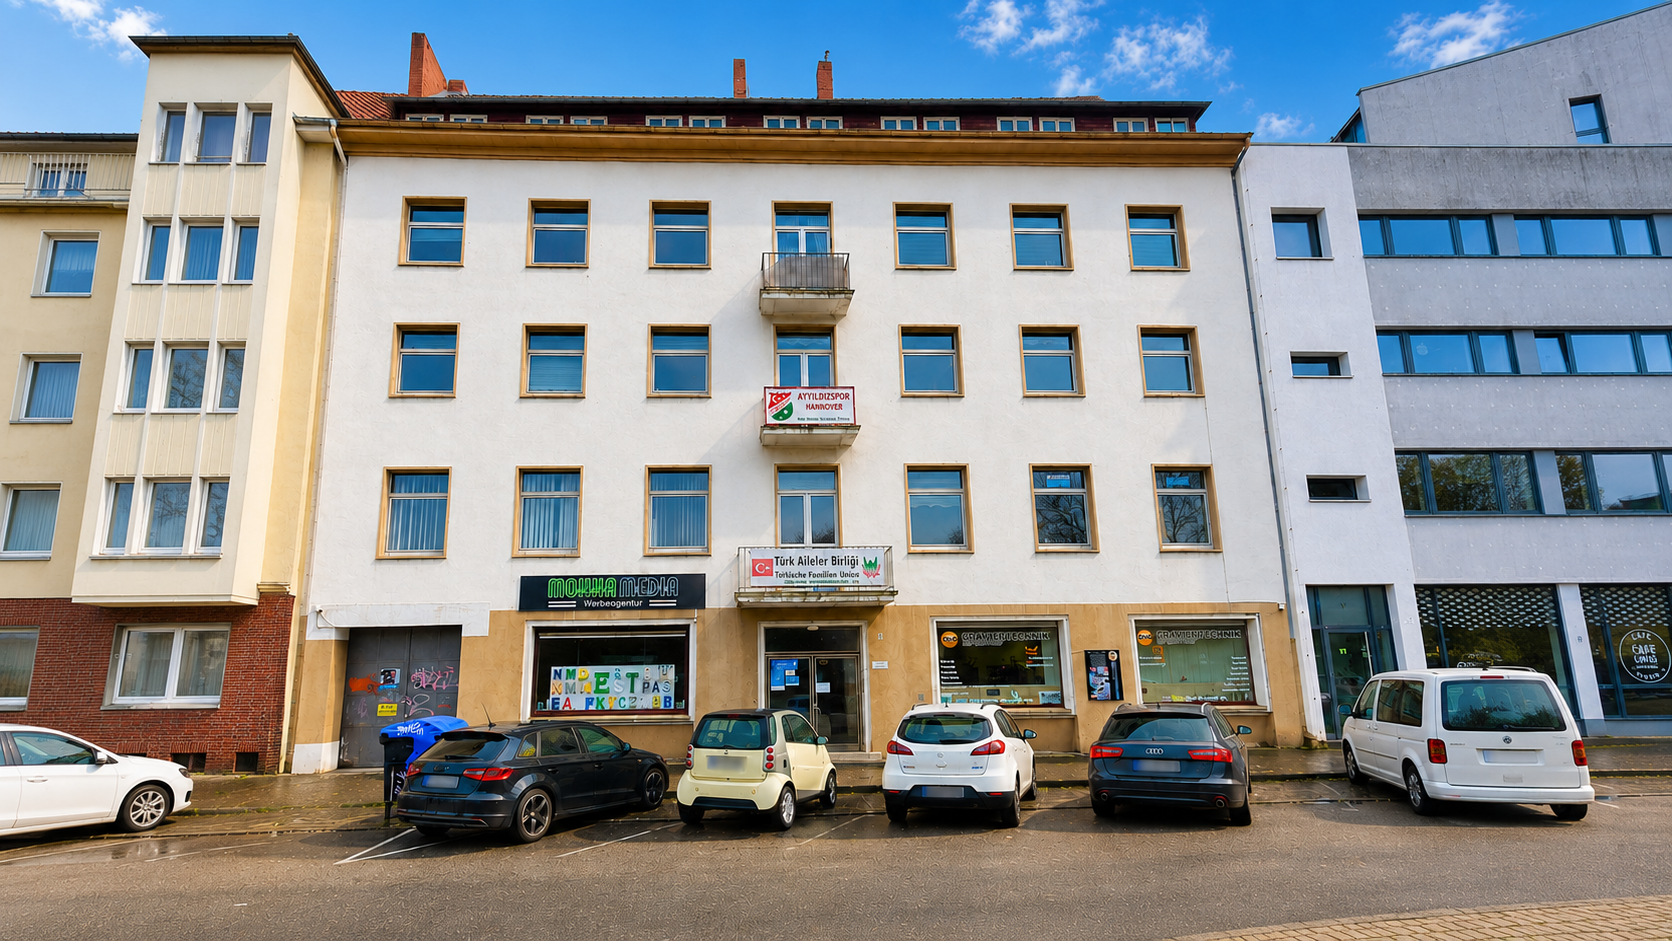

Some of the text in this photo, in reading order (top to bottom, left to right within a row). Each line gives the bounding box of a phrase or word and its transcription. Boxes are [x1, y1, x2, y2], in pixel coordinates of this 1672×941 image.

[797, 392, 850, 401] AYYILDIZSPOR
[774, 555, 795, 566] Türk
[797, 555, 829, 566] Aileler
[619, 576, 679, 597] MEDIA
